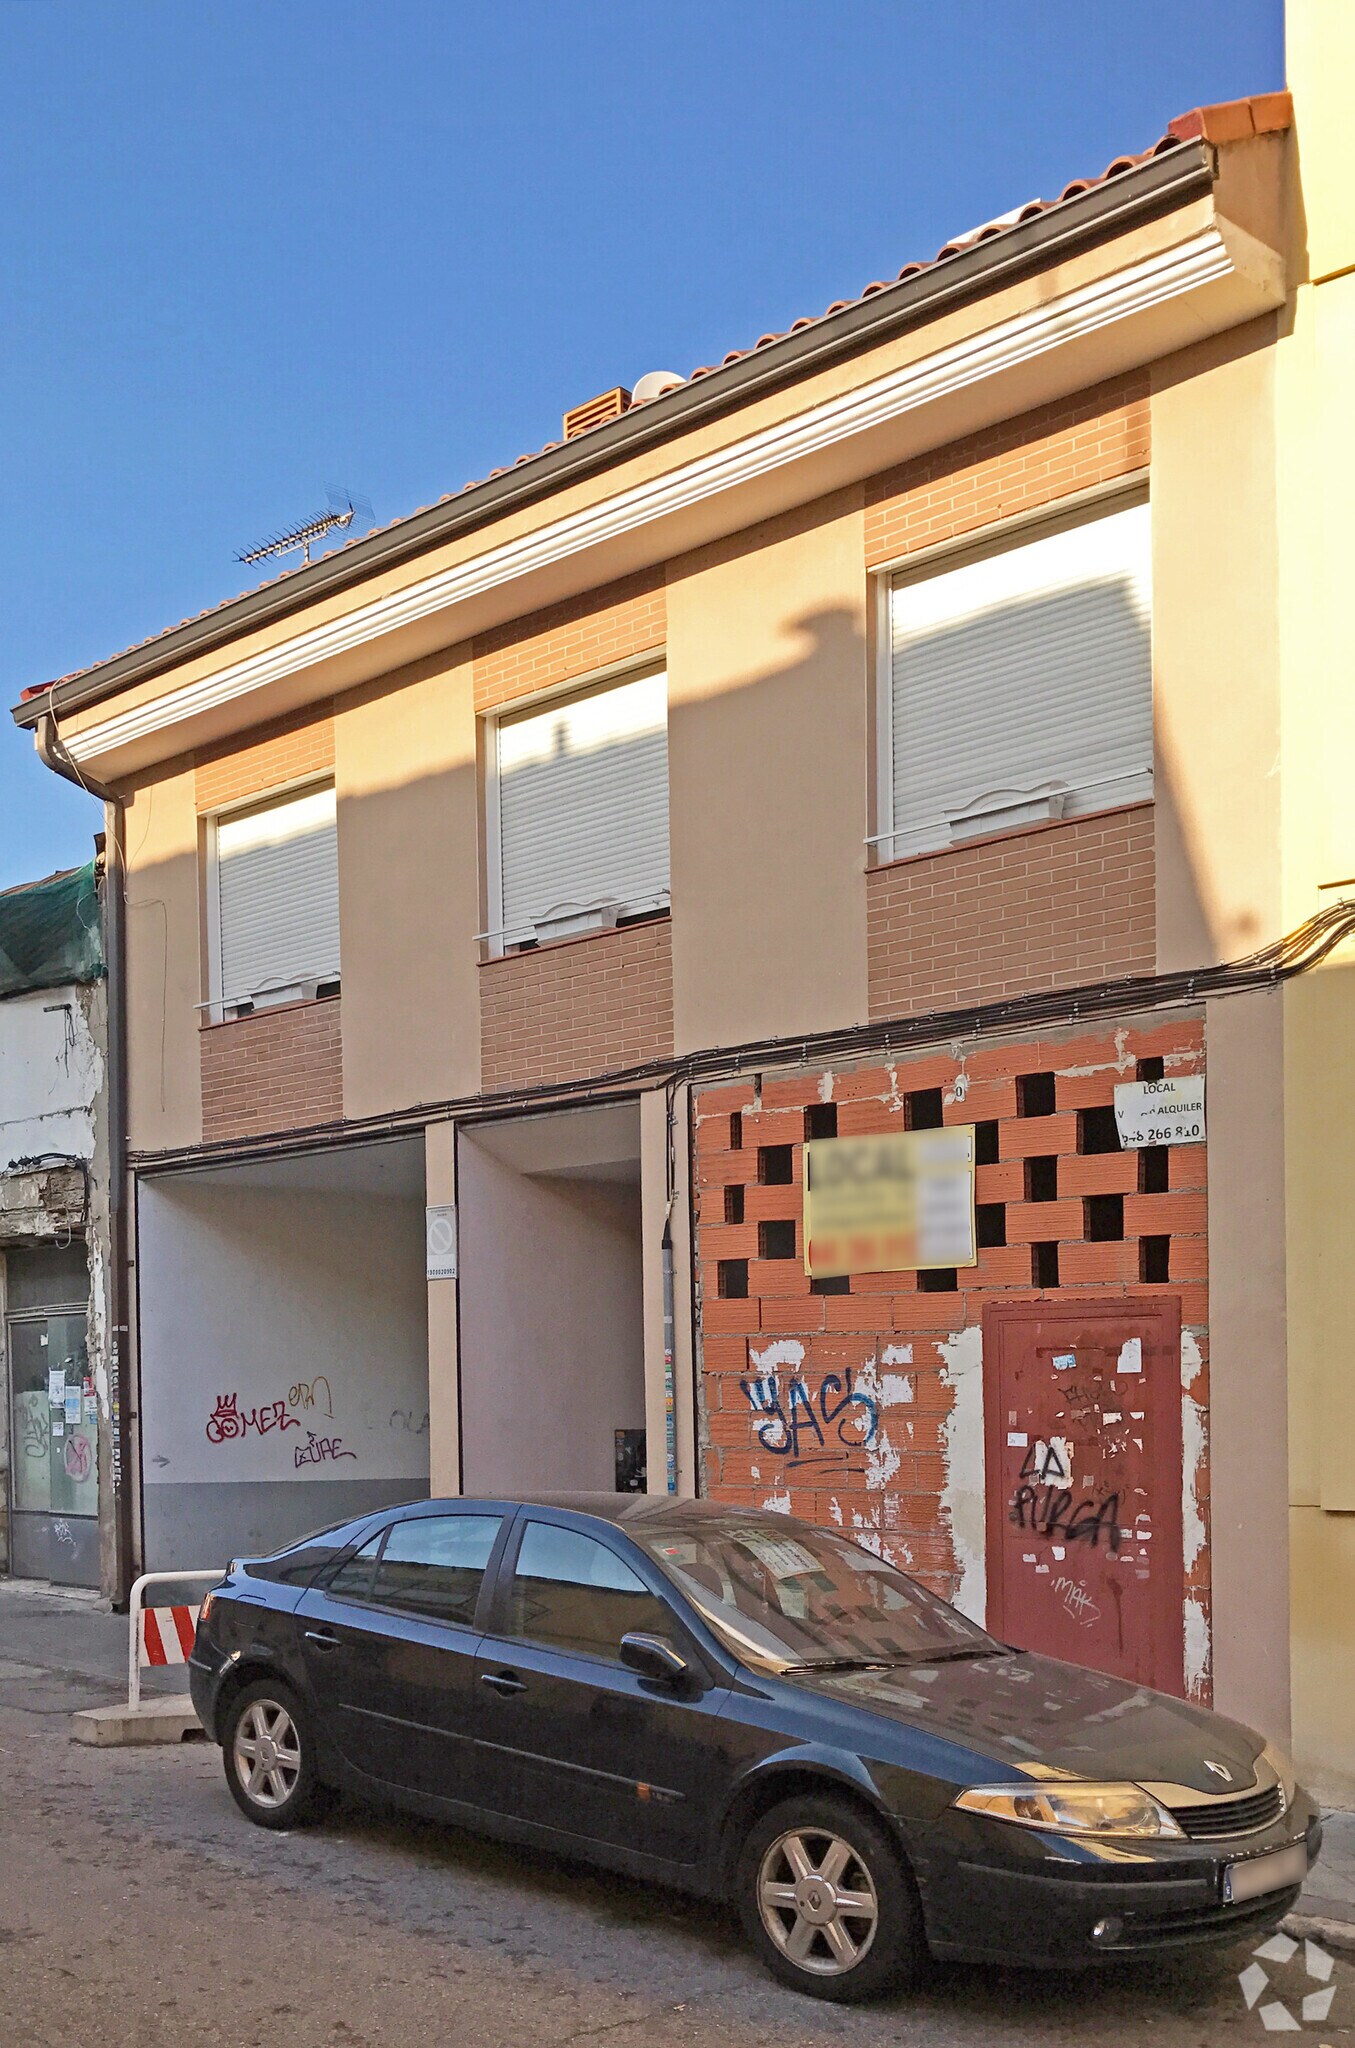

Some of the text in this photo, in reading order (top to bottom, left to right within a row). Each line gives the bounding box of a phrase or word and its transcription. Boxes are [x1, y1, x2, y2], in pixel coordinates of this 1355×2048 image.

[1143, 1082, 1176, 1094] LOCAL
[1157, 1102, 1202, 1115] ALQUILER
[1148, 1127, 1172, 1140] 266
[1020, 1446, 1066, 1480] LA
